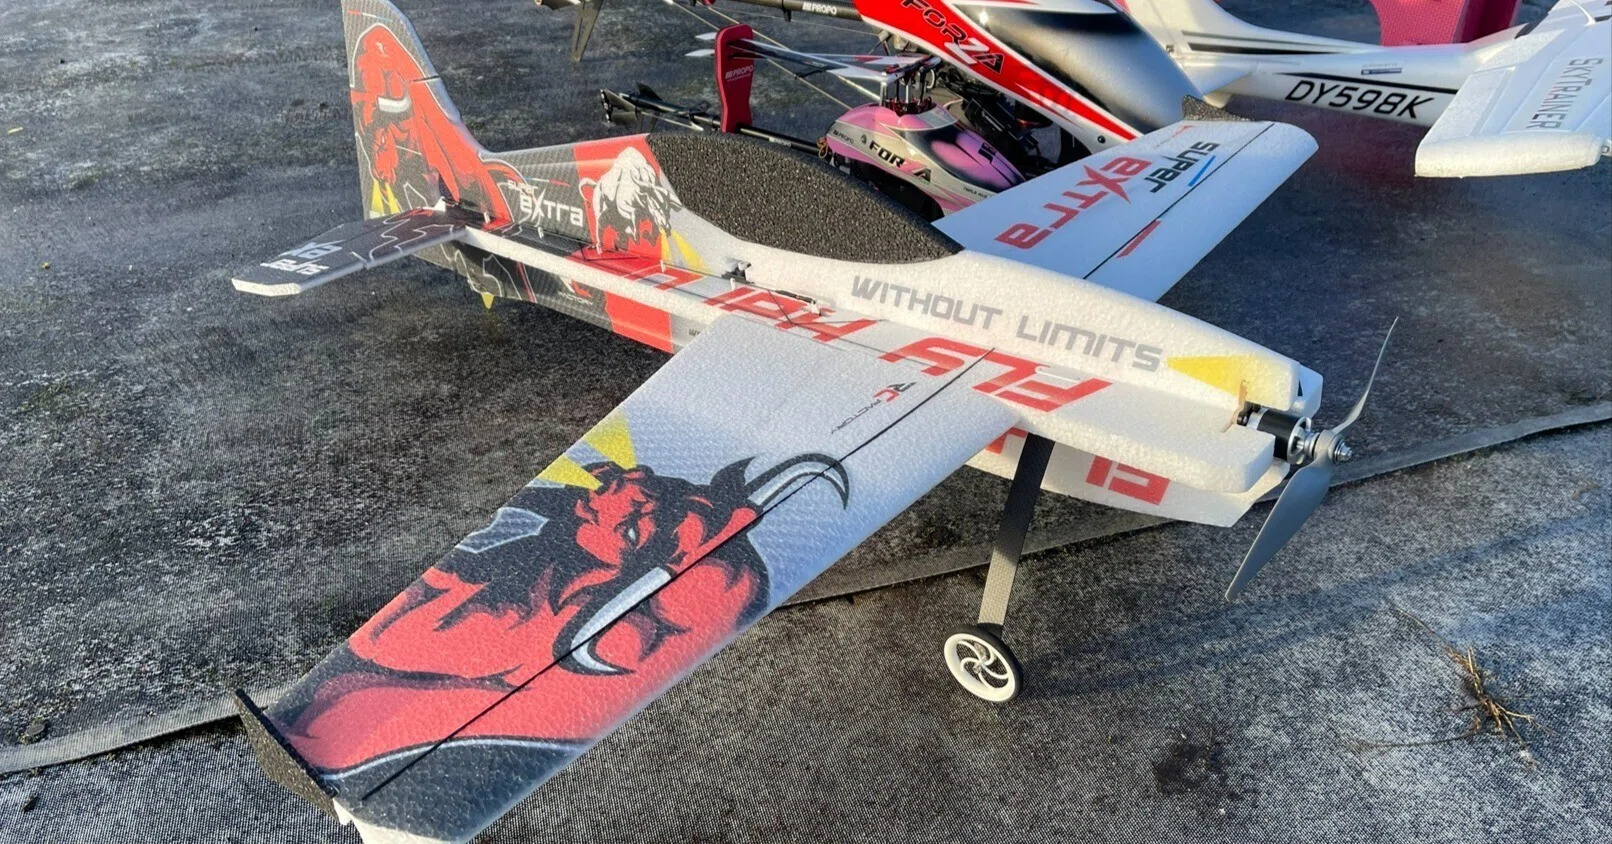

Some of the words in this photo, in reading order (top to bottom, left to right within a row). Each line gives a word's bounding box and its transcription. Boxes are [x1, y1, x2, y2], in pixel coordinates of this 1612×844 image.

[811, 3, 838, 16] PROPO
[1284, 79, 1435, 119] DY598K
[1525, 57, 1604, 129] SKYTRAINER
[850, 275, 1003, 331] WITHOUT
[1015, 314, 1164, 373] LIMITS
[876, 335, 1114, 413] FLY
